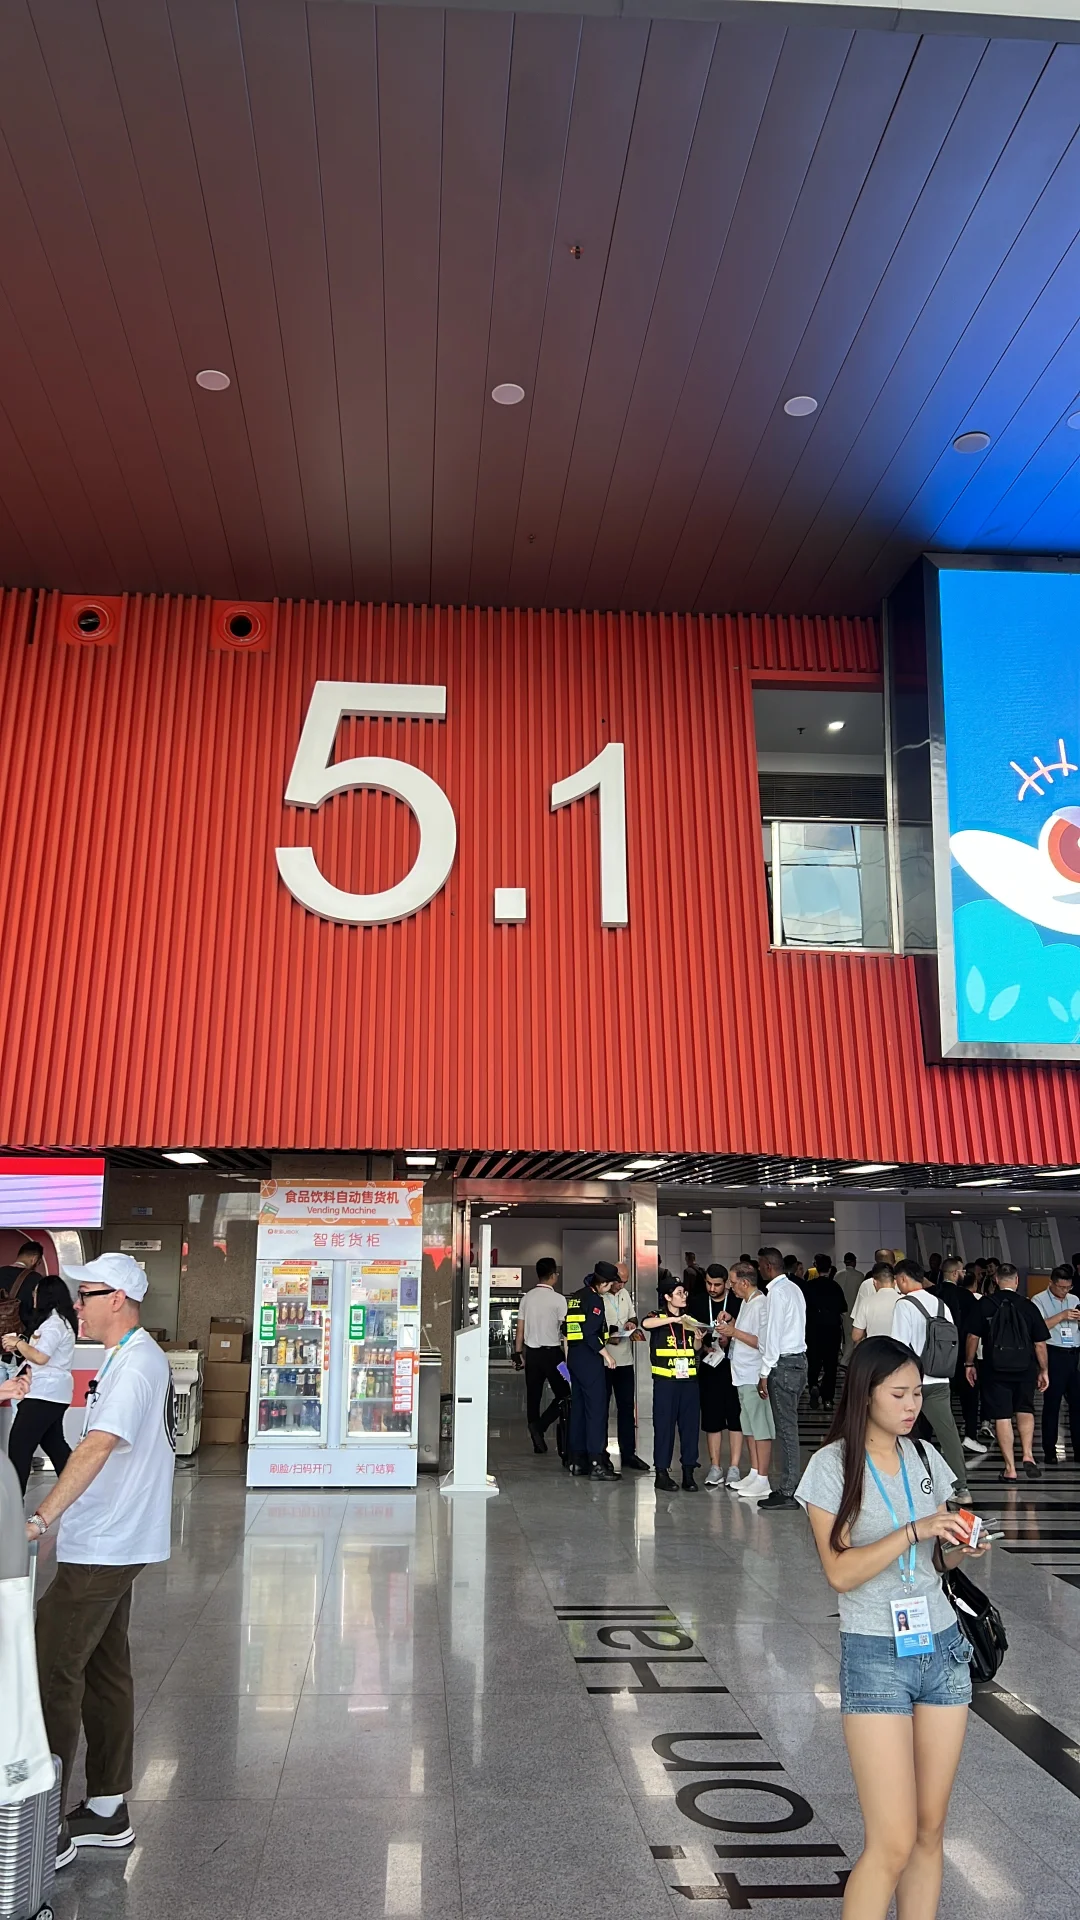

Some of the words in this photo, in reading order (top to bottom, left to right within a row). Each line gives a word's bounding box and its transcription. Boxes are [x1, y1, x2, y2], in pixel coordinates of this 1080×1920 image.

[275, 681, 628, 928] 5.1
[285, 1190, 399, 1204] 食品饮料自动售货机
[307, 1206, 340, 1215] Vending
[342, 1206, 376, 1214] Machine
[313, 1233, 380, 1247] 智能货柜
[269, 1464, 332, 1475] 刷脸/扫码开门
[356, 1464, 395, 1475] 关门结算
[553, 1605, 730, 1694] Hall
